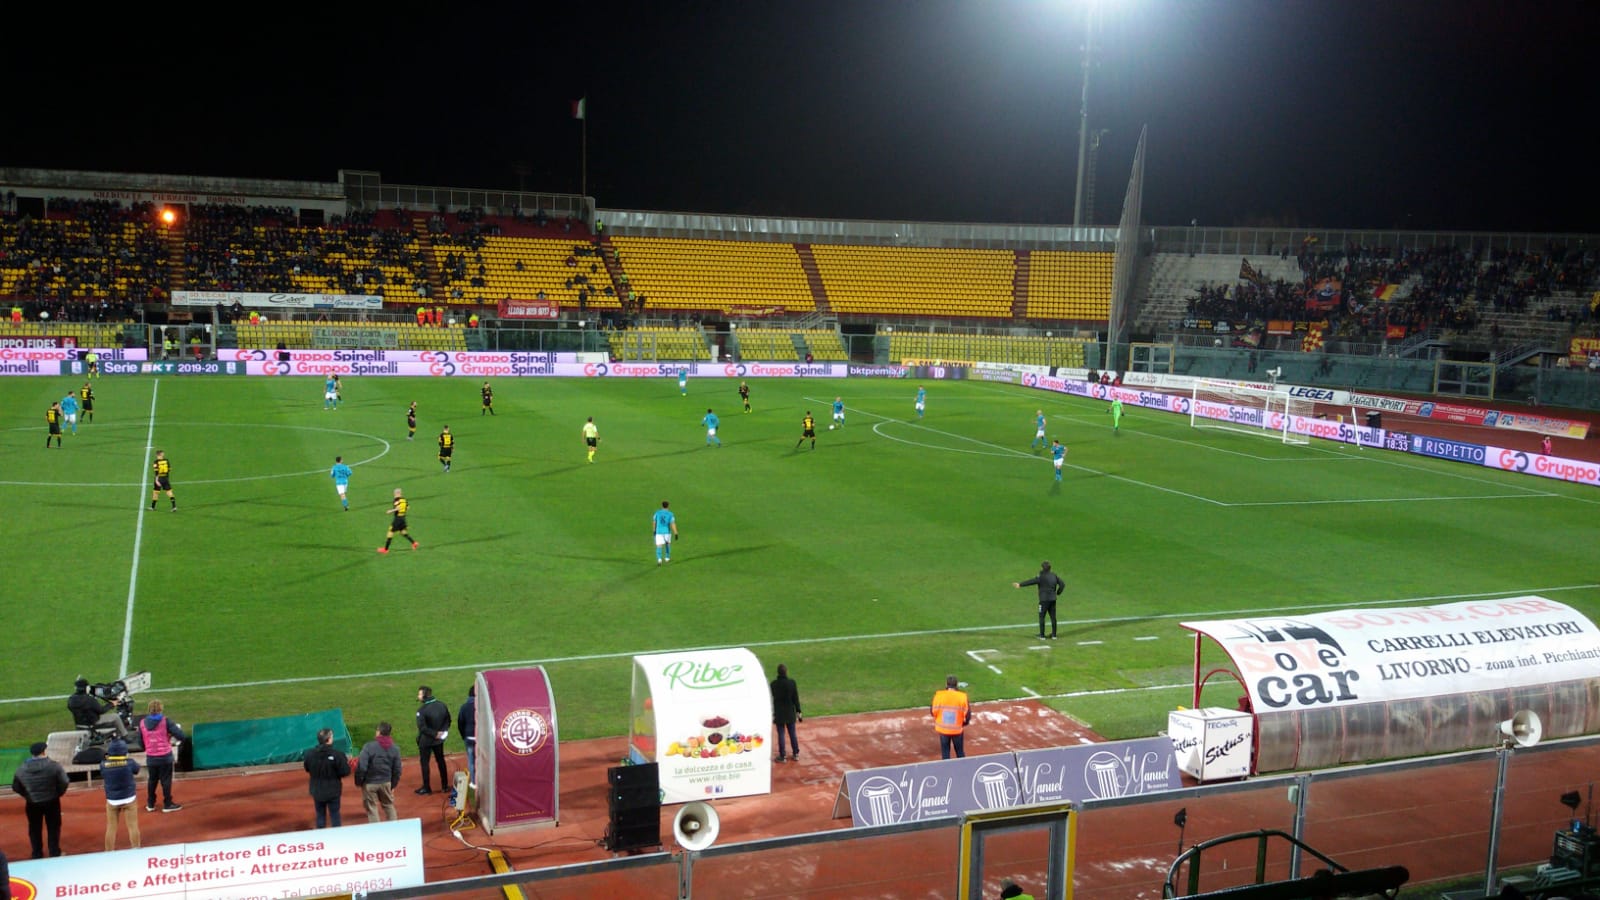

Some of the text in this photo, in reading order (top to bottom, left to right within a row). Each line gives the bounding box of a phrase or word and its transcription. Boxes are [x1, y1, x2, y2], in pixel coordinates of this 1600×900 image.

[26, 338, 57, 349] FIDES
[333, 349, 385, 361] Spinelli
[455, 351, 509, 363] Gruppo
[510, 351, 558, 363] Spinelli
[104, 361, 219, 374] Serie BKT 2019-20
[296, 361, 350, 374] Gruppo
[351, 361, 398, 375] Spinelli
[461, 363, 510, 376] Gruppo
[511, 361, 555, 376] Spinelli
[612, 363, 658, 377] Gruppo
[751, 363, 793, 377] Gruppo
[794, 361, 832, 377] Spinelli
[1039, 374, 1064, 392] Gruppo
[1064, 379, 1087, 395] Spinelli
[1289, 386, 1335, 401] LEGEA
[1109, 387, 1139, 403] Gruppo
[1139, 391, 1169, 408] Spinelli
[1380, 398, 1405, 412] SPORT
[1194, 401, 1229, 418] Gruppo
[1229, 406, 1264, 424] Spinelli
[1296, 417, 1338, 438] Gruppo
[1426, 439, 1484, 462] RISPETTO
[1535, 455, 1597, 482] Gruppo
[1367, 620, 1585, 654] CARRELLI ELEVATORI
[1377, 657, 1471, 681] LIVORNO
[1486, 658, 1516, 672] zona
[1516, 654, 1542, 667] ind.
[1257, 669, 1360, 708] car
[1205, 733, 1245, 766] Sixtus
[684, 764, 718, 773] dolcezza
[735, 761, 752, 769] casa
[147, 841, 325, 869] Registratore di Cassa
[55, 881, 121, 898] Bilance
[127, 879, 138, 890] e
[143, 866, 235, 887] Affettatrici
[250, 854, 349, 875] Attrezzature
[354, 846, 407, 864] Negozi
[346, 877, 393, 893] 864634
